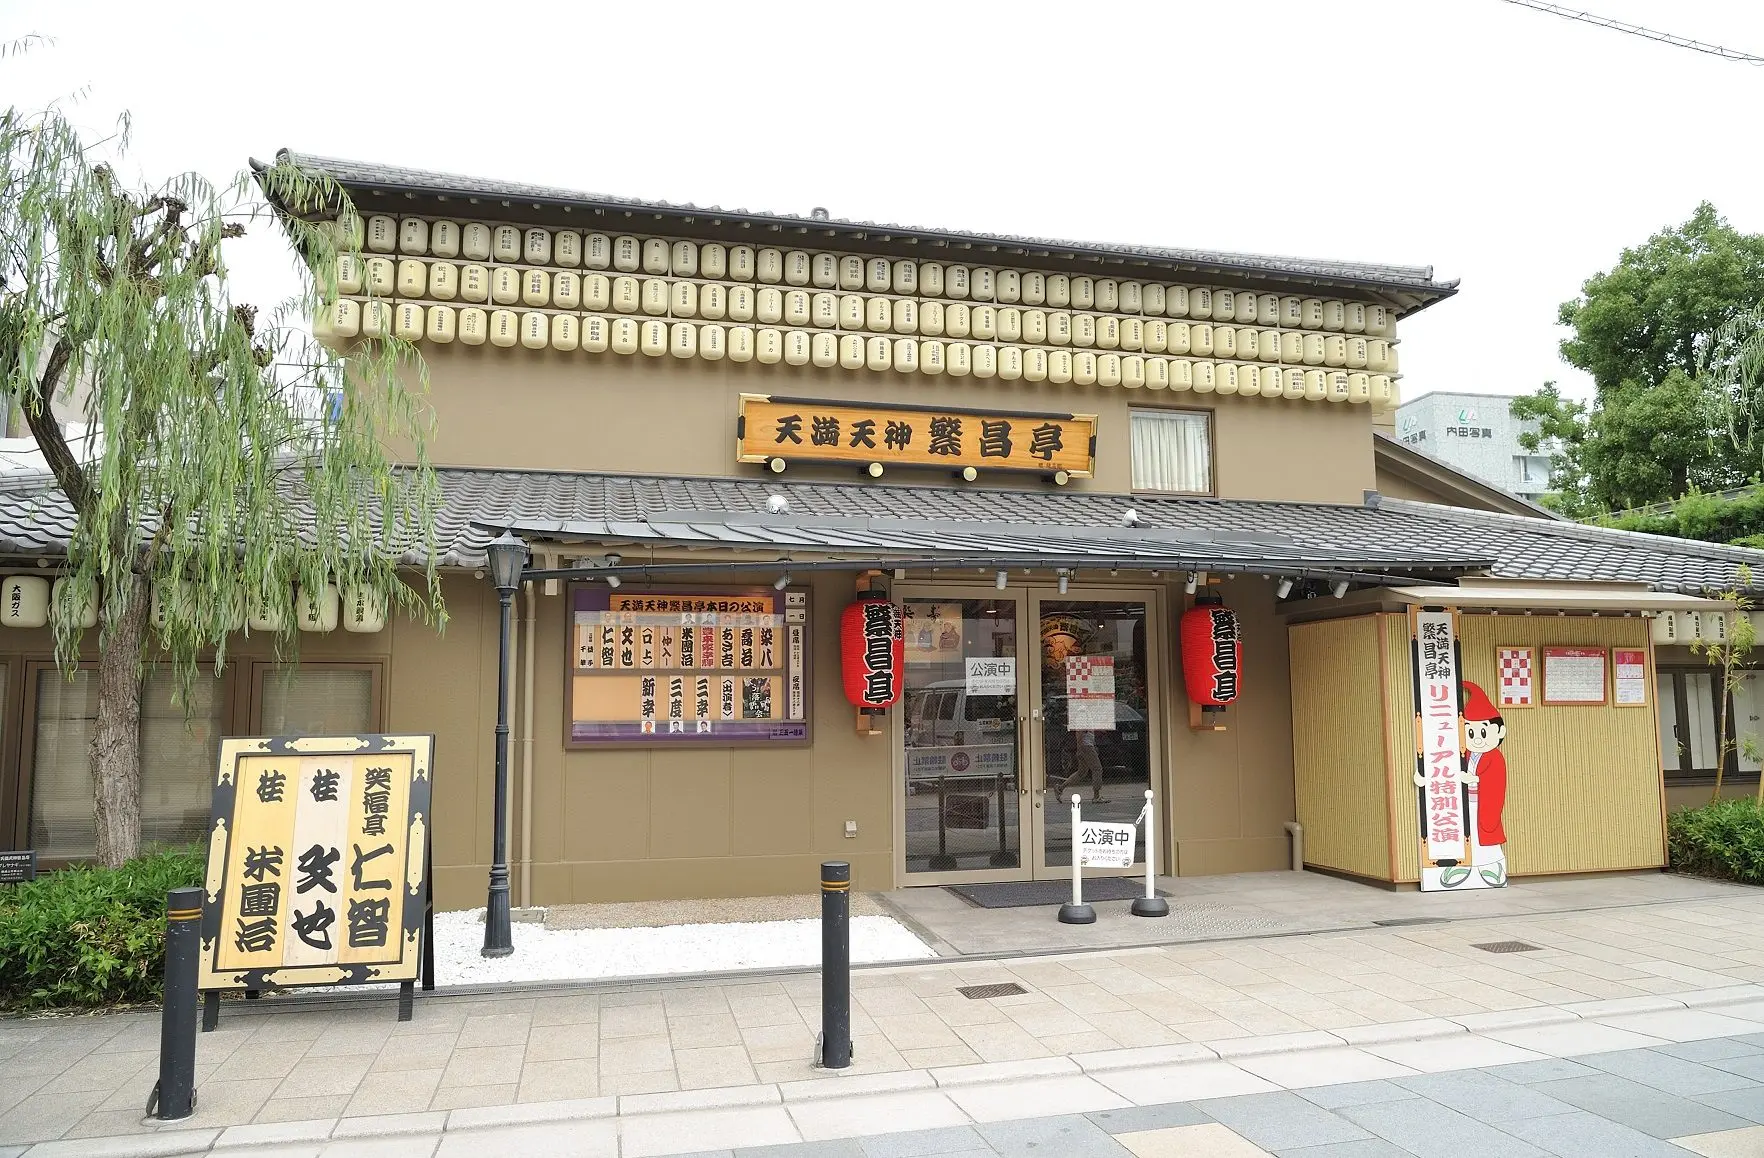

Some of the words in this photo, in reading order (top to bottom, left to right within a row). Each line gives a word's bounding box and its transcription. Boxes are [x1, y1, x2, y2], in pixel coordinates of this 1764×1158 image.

[774, 414, 1064, 461] 天満天神繁昌亭
[1446, 426, 1492, 439] 内田写真
[11, 584, 21, 618] 大阪ガス
[863, 603, 895, 704] 繁昌亭
[970, 660, 1011, 677] 公演中
[1211, 609, 1238, 703] 繁昌亭
[1422, 622, 1438, 680] 繁昌亭
[1436, 622, 1451, 679] 天満天神
[256, 769, 287, 803] 桂
[310, 769, 340, 802] 桂
[1429, 684, 1460, 843] リニューアル特別公演
[362, 767, 392, 836] 笑福亭
[1081, 827, 1129, 846] 公演中
[291, 843, 341, 951] 文也
[347, 843, 395, 948] 仁智
